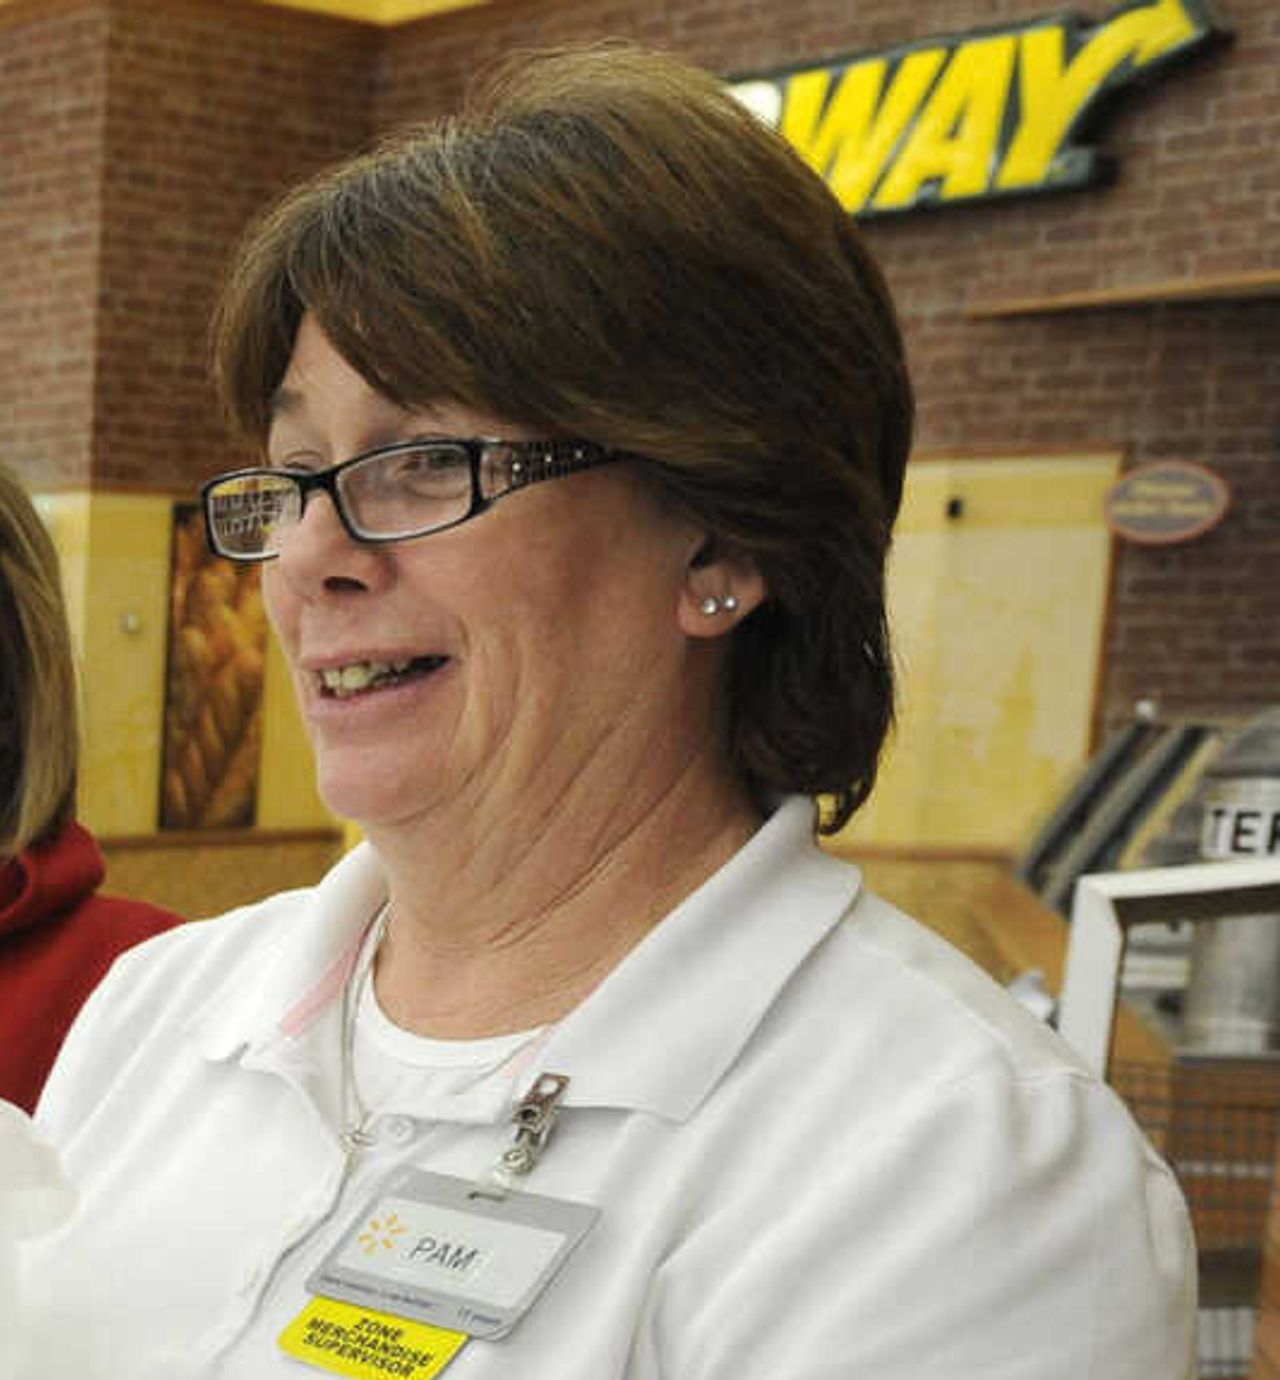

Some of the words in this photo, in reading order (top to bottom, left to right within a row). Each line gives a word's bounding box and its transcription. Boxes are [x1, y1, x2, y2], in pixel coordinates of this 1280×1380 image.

[730, 0, 1199, 212] WAY
[407, 1235, 480, 1271] PAM
[306, 1316, 434, 1368] MERCHANDISE
[354, 1316, 406, 1342] ZONE
[303, 1332, 416, 1379] SUPERVISOR
